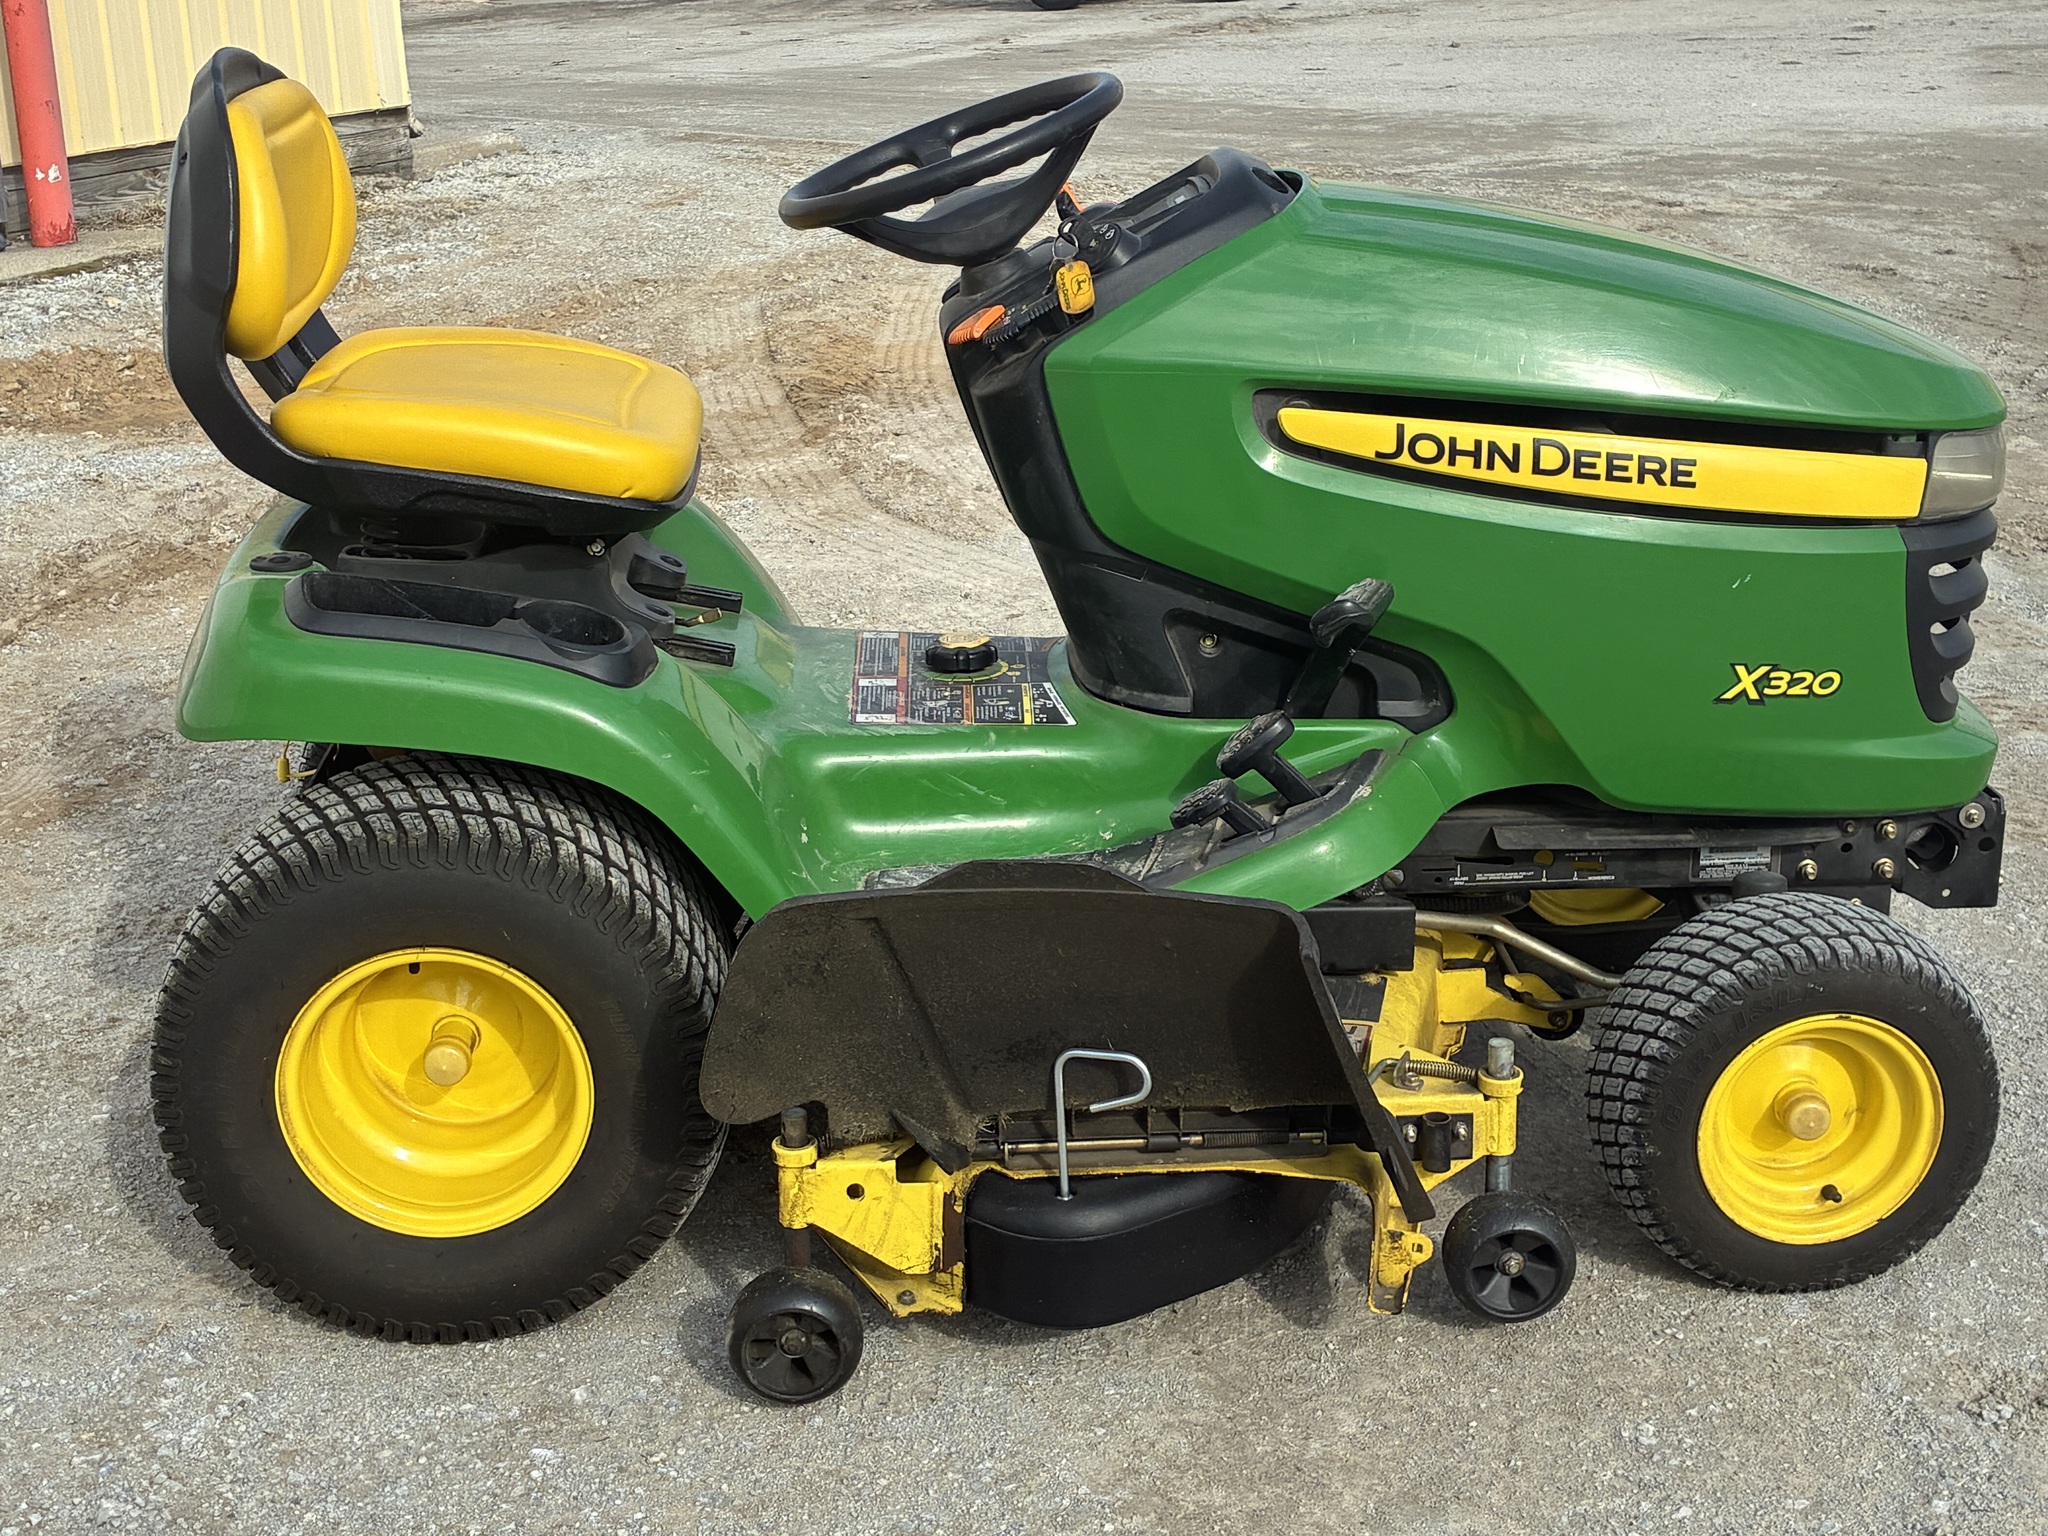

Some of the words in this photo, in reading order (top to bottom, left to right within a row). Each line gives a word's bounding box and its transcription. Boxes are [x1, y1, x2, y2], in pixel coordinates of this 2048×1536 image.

[1375, 423, 1521, 474] JOHN
[1532, 437, 1697, 489] DEERE
[1713, 663, 1843, 706] X320
